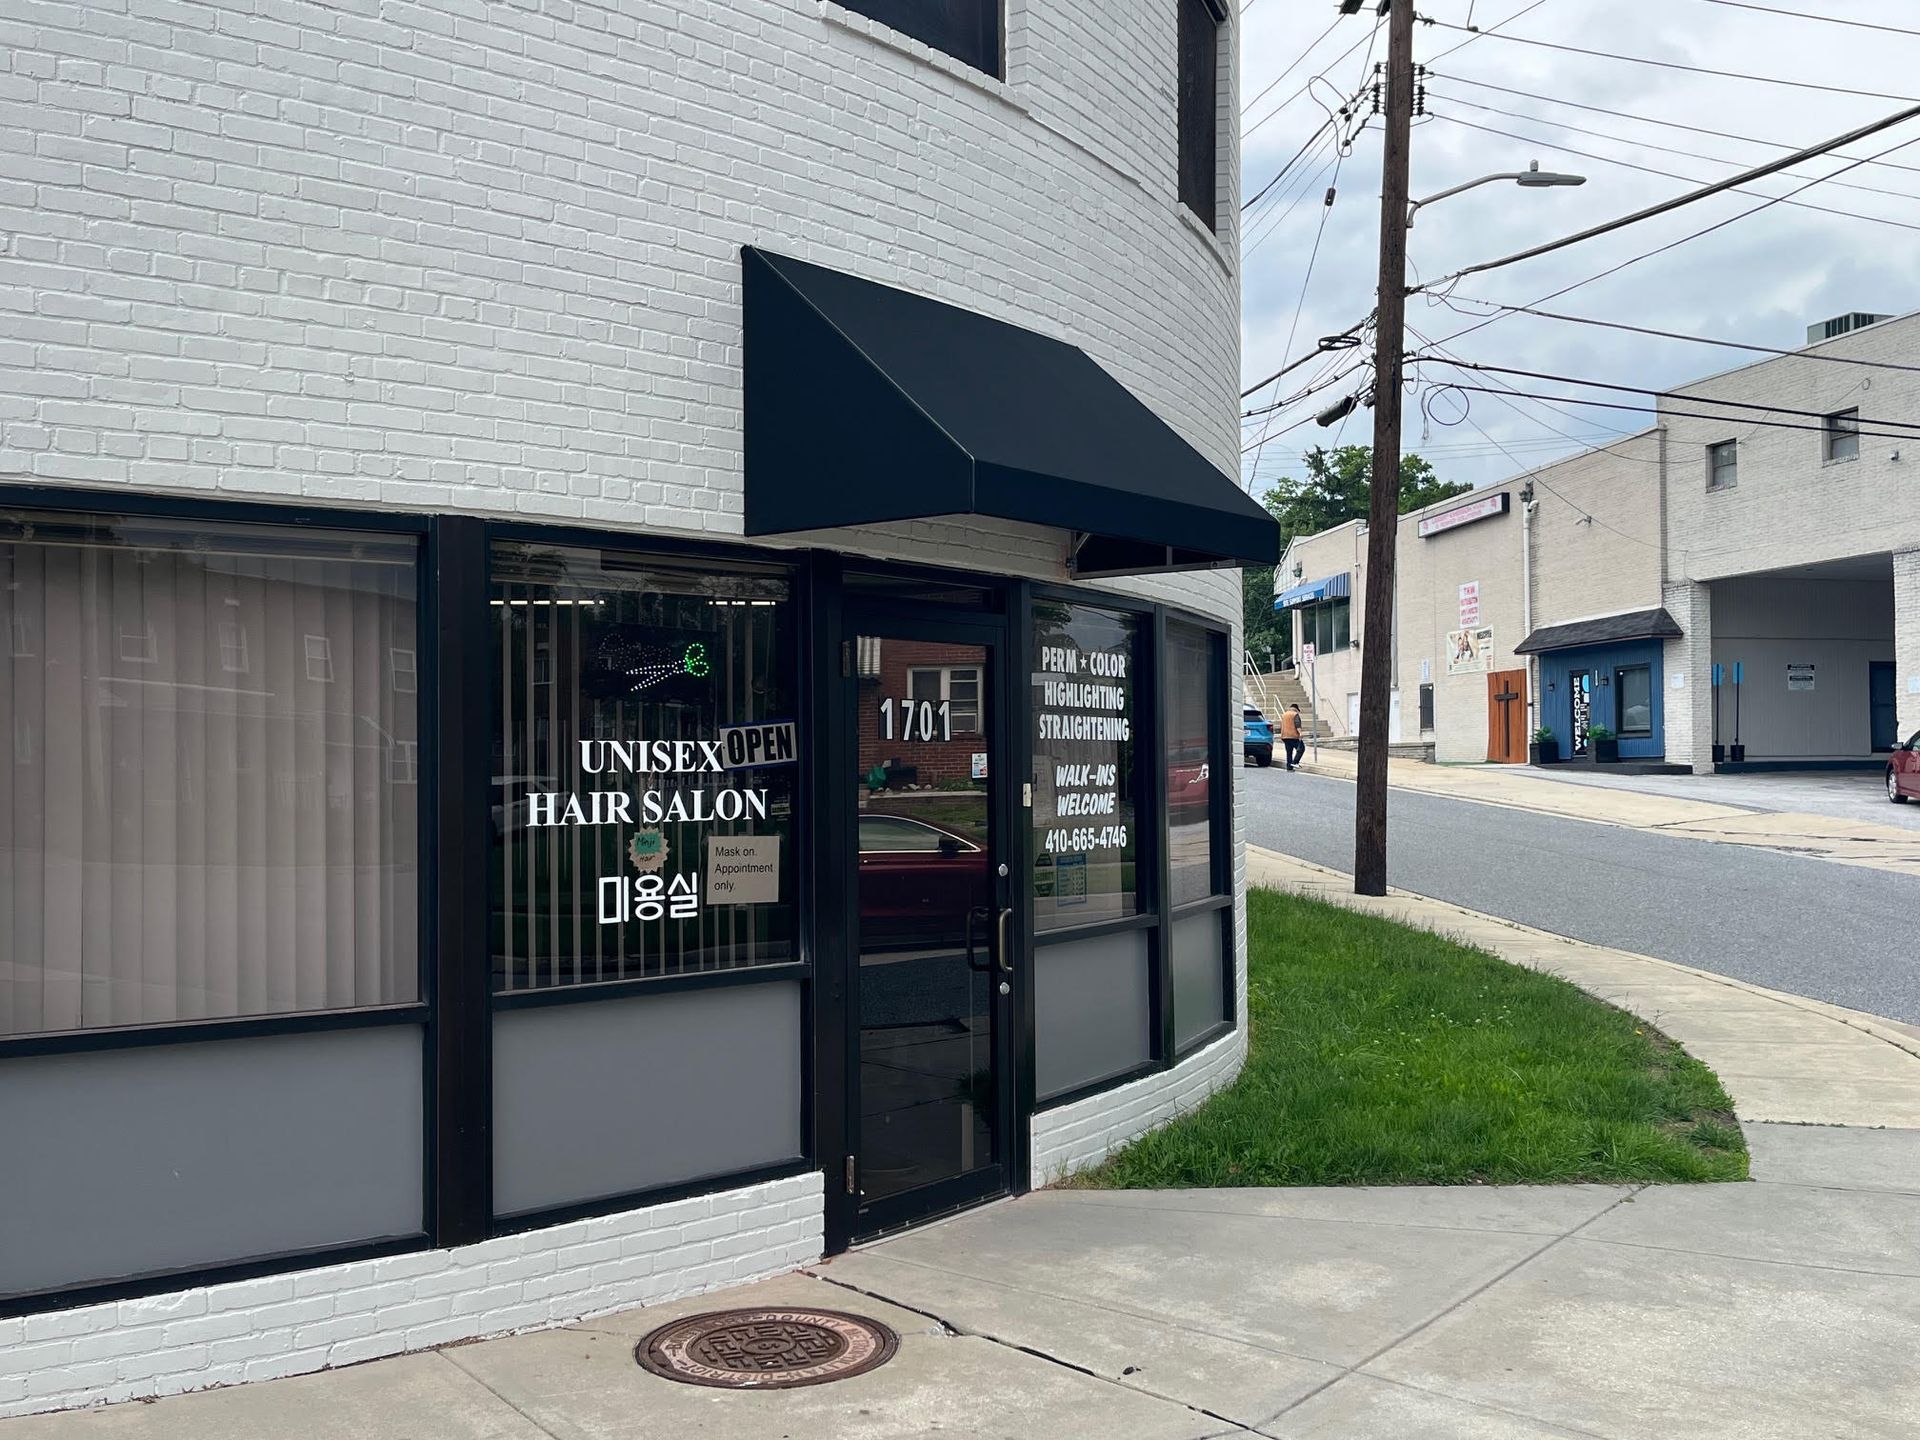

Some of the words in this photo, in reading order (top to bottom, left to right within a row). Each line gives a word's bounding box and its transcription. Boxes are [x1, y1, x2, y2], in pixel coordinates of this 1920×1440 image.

[1042, 646, 1077, 673] PERM
[1090, 652, 1126, 678] COLOR
[1044, 681, 1125, 710] HIGHLIGHTING
[880, 698, 951, 741] 1701
[1039, 713, 1130, 741] STRAIGHTENING
[1573, 677, 1582, 751] WELCOME
[578, 739, 724, 774] UNISEX
[727, 725, 792, 765] OPEN
[1056, 764, 1116, 787] WALK-INS
[525, 791, 634, 827] HAIR
[642, 789, 768, 824] SALON
[1057, 792, 1116, 817] WELCOME
[715, 847, 740, 857] Mask
[1045, 825, 1127, 853] 410-665-4746
[714, 863, 773, 876] Appointment
[598, 872, 698, 924] 미용실
